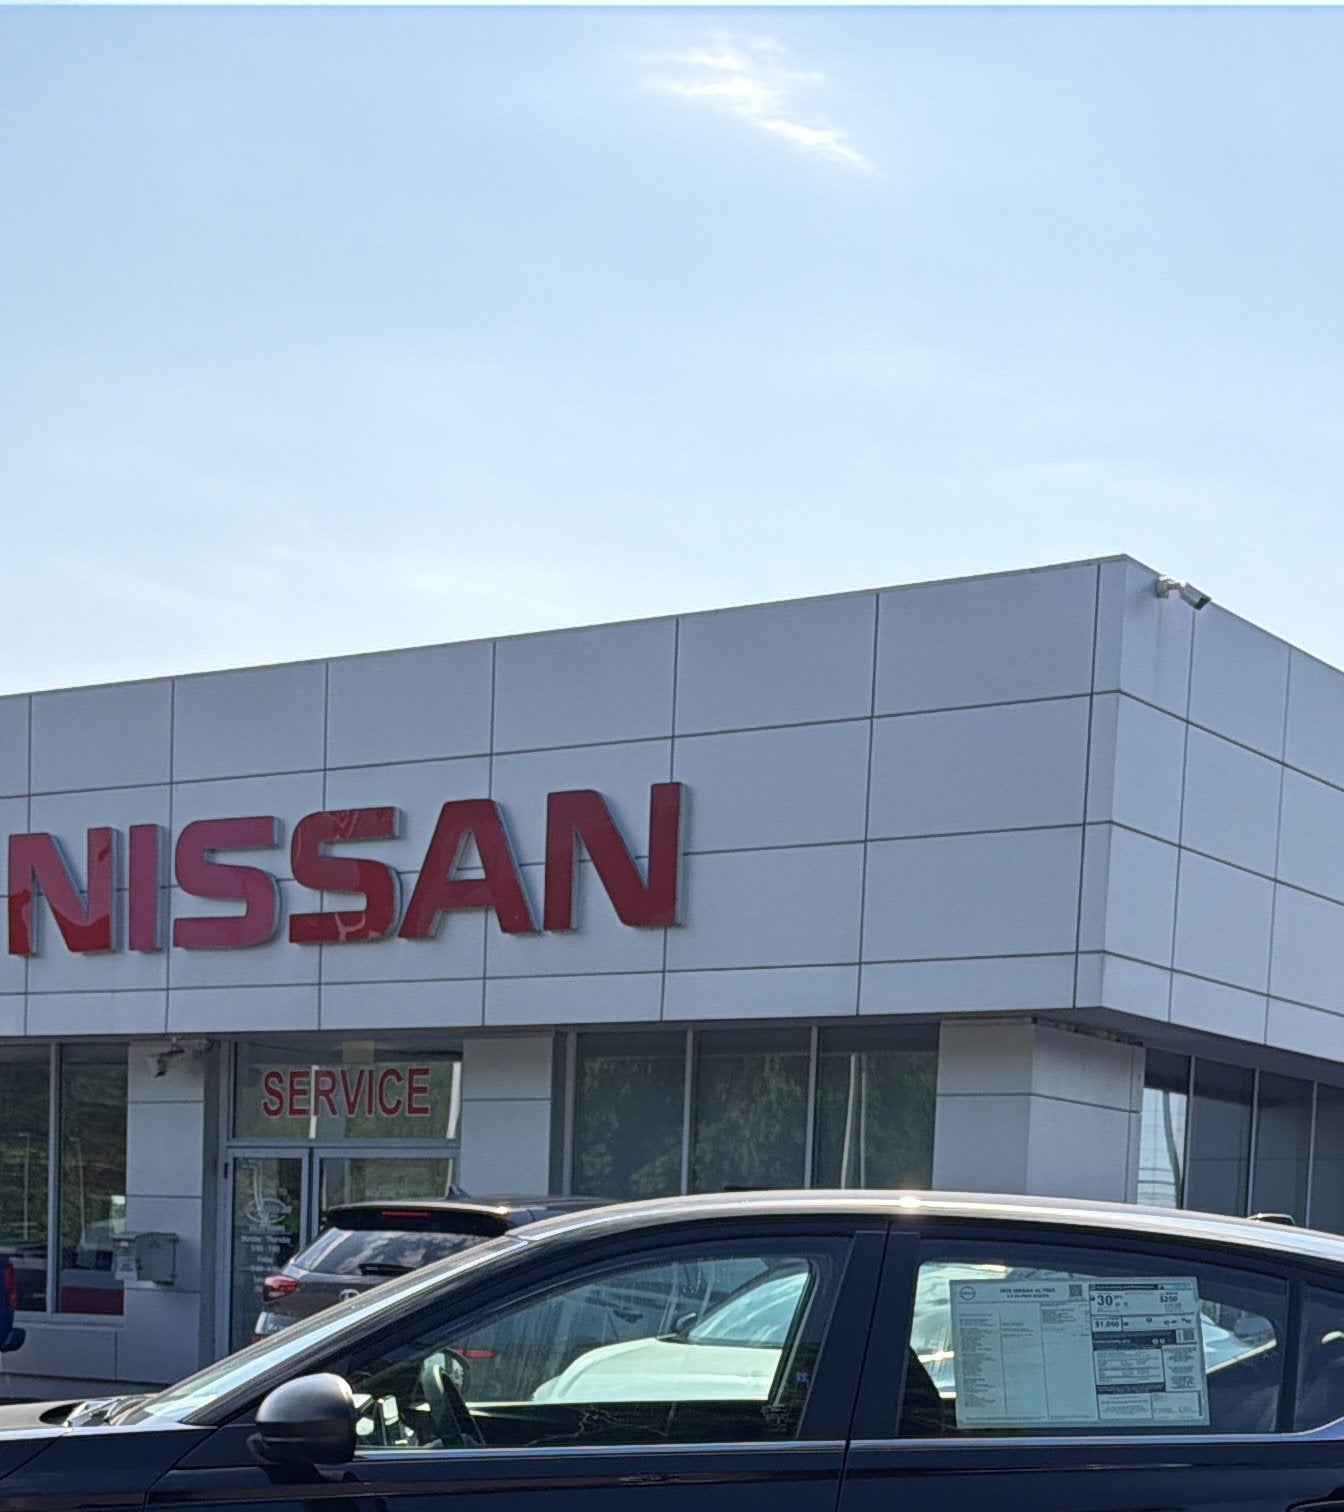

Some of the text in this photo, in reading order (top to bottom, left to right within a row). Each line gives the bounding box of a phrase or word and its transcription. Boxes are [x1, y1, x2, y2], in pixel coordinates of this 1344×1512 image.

[8, 782, 683, 956] NISSAN
[262, 1068, 431, 1118] SERVICE
[1097, 1295, 1113, 1306] 30
